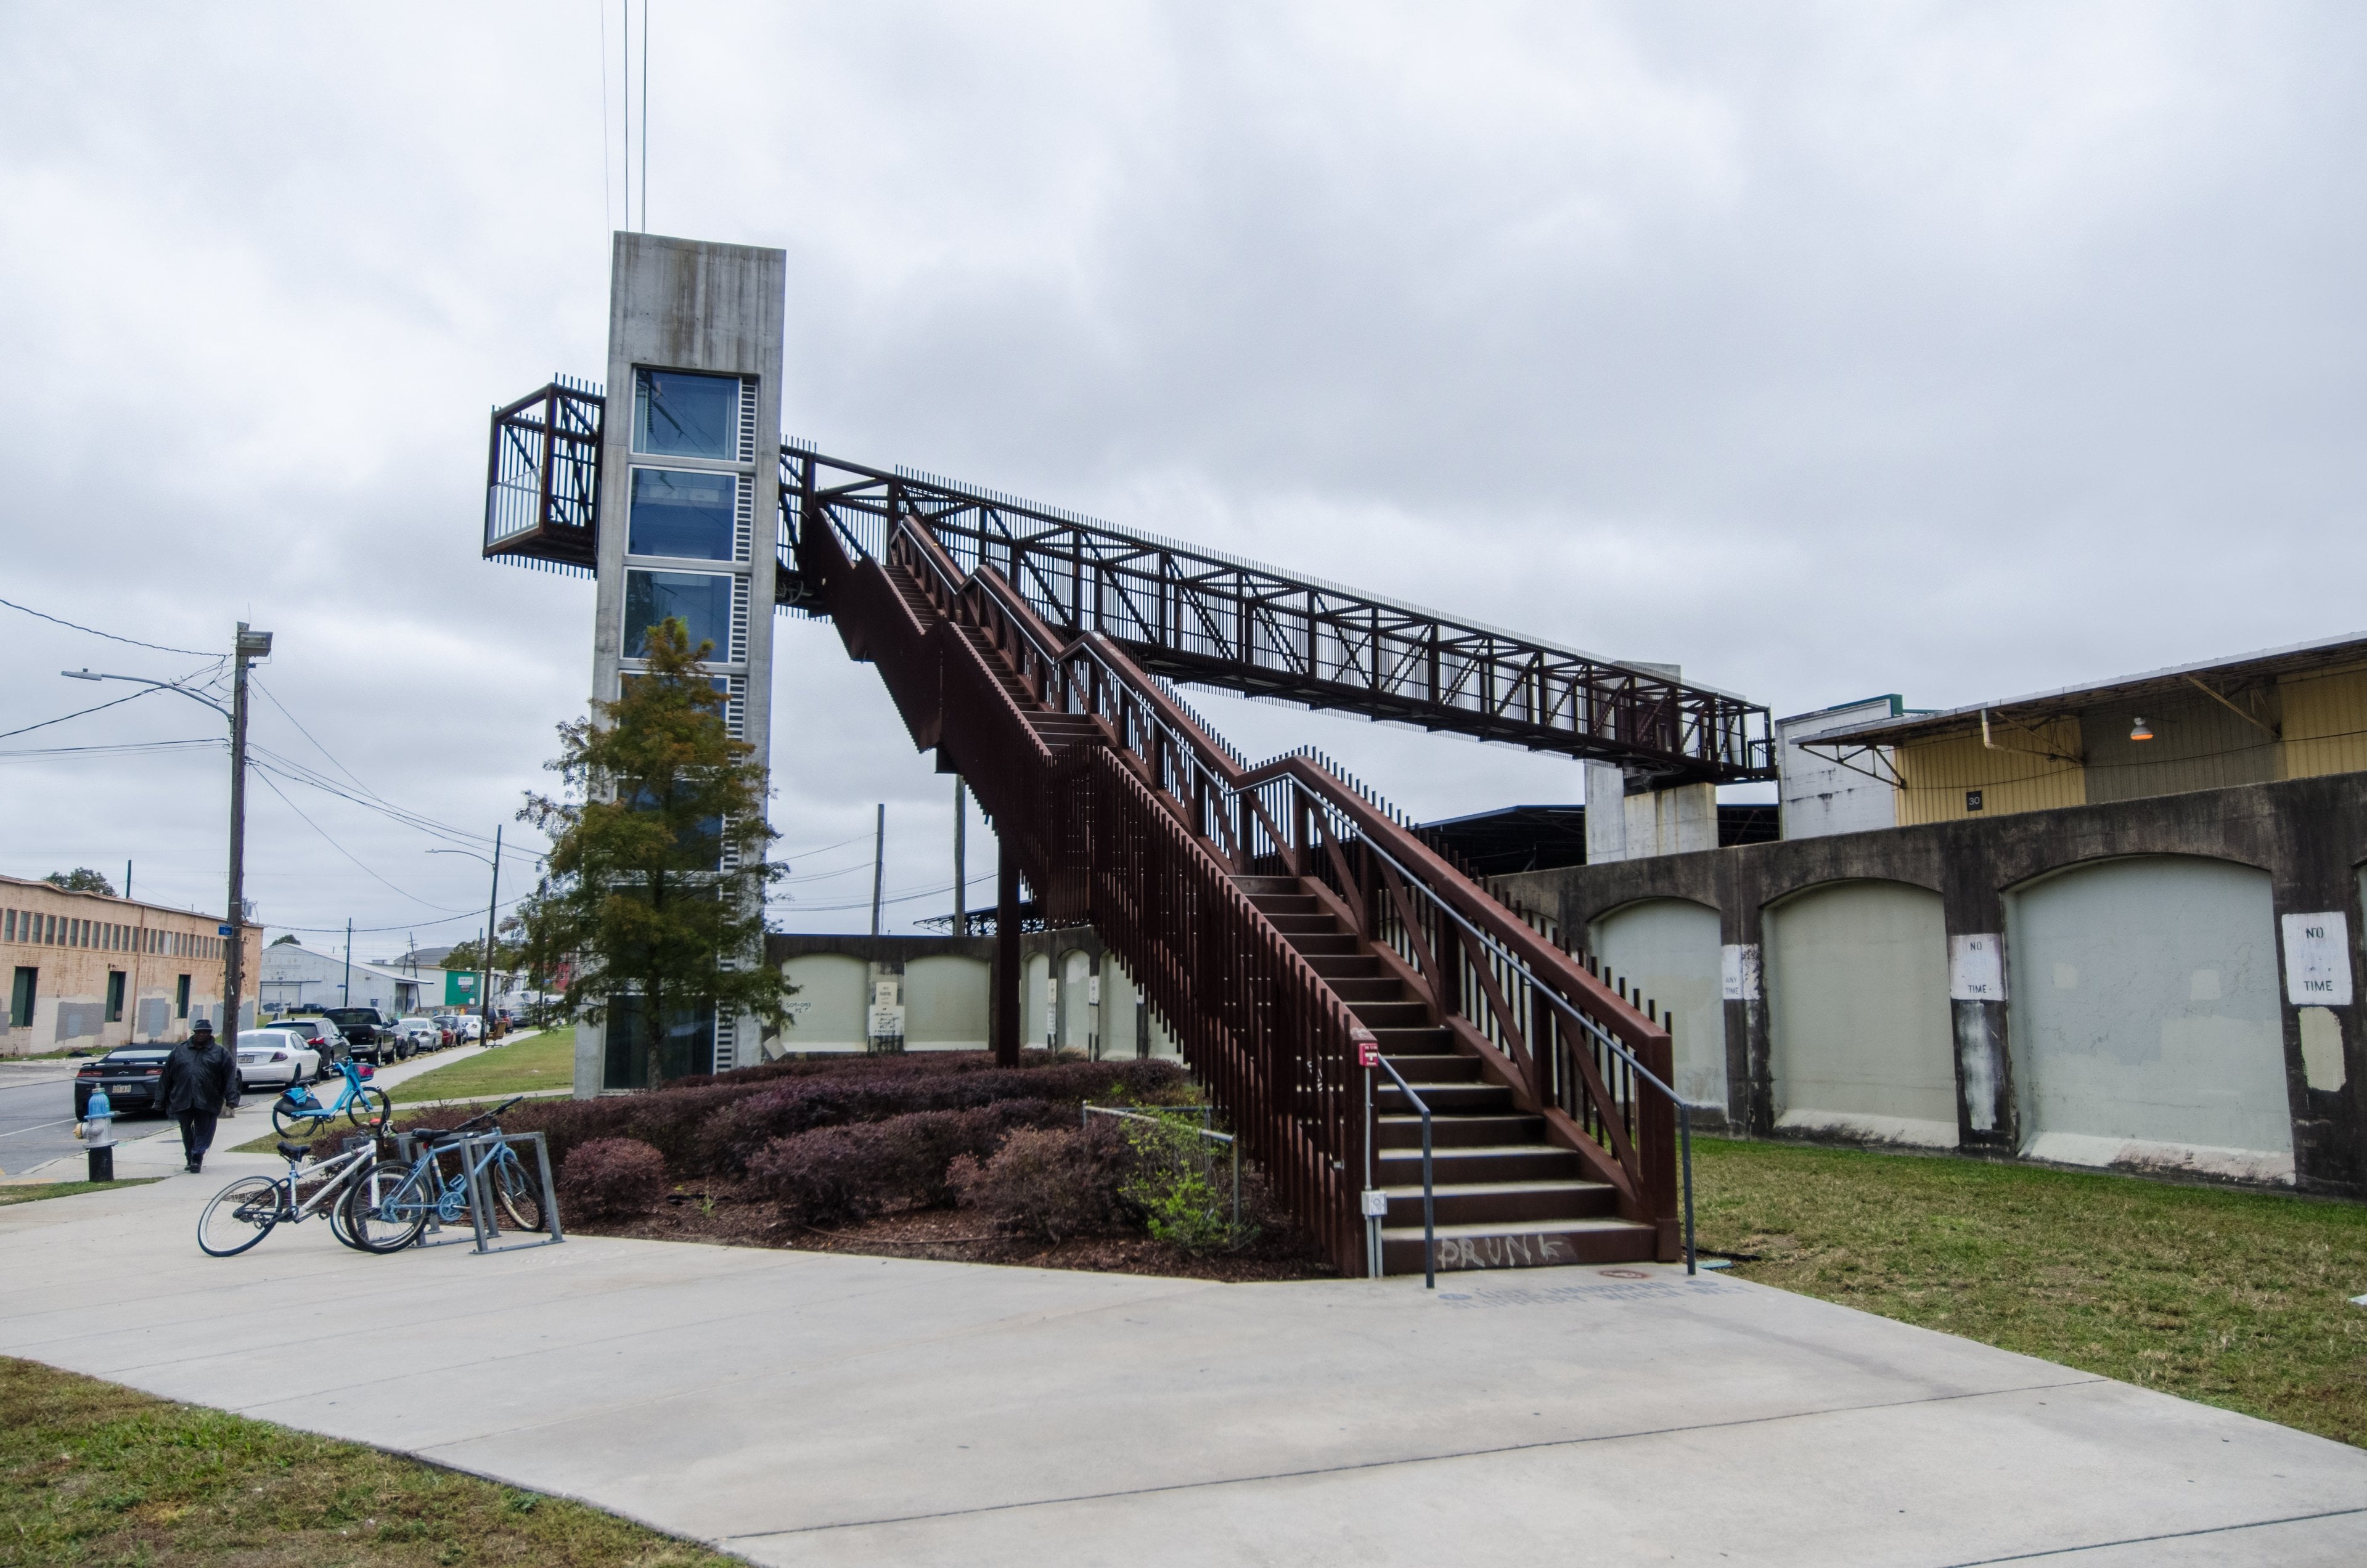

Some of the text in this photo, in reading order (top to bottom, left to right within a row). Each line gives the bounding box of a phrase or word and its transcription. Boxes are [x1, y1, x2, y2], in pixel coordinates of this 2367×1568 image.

[1969, 796, 1981, 805] 30
[2305, 927, 2324, 938] NO
[1970, 941, 1982, 950] NO
[1725, 987, 1739, 995] TIME
[1968, 984, 1987, 994] TIME
[2303, 981, 2333, 991] TIME
[1541, 1282, 1685, 1295] HANDRAIL
[1592, 1289, 1686, 1301] WHEN
[1685, 1286, 1756, 1295] WET
